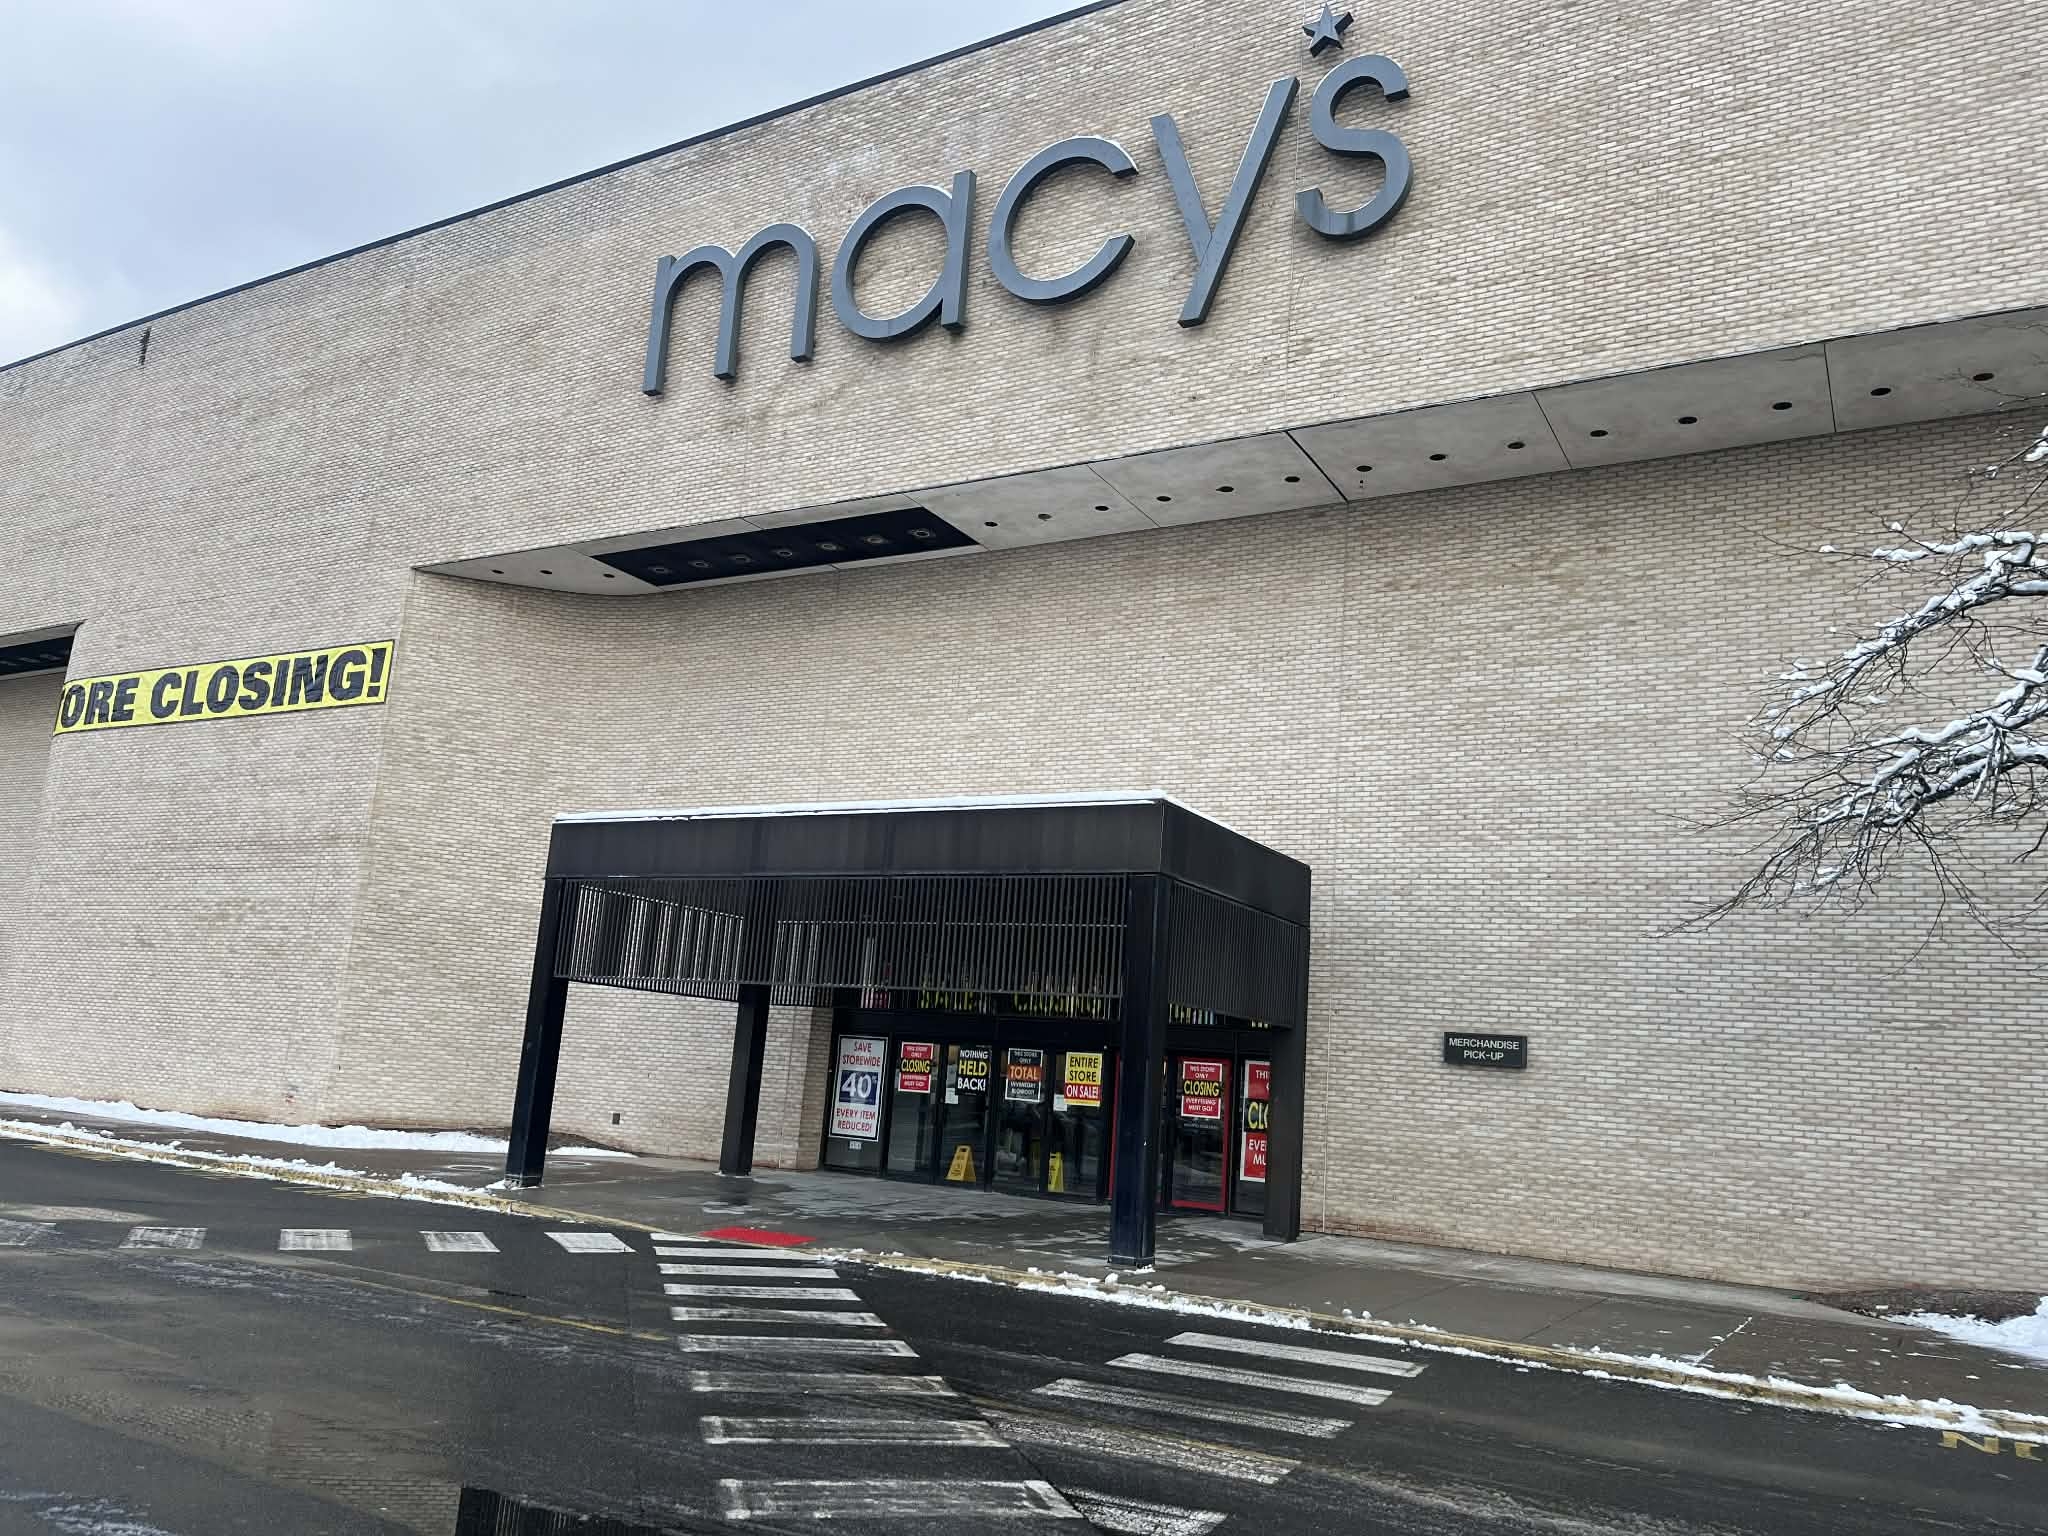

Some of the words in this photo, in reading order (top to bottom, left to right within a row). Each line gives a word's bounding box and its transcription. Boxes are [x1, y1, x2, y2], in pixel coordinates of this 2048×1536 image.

[60, 677, 140, 728] ORE
[150, 647, 388, 719] CLOSING!
[854, 1041, 872, 1052] SAVE
[1449, 1037, 1519, 1050] MERCHANDISE
[960, 1049, 989, 1059] NOTHING
[1463, 1050, 1504, 1060] PICK-UP
[842, 1055, 880, 1066] STOREWIDE
[901, 1059, 930, 1073] CLOSING
[1070, 1056, 1098, 1068] ENTIRE
[959, 1060, 987, 1076] HELD
[1010, 1066, 1038, 1080] TOTAL
[1070, 1070, 1096, 1082] STORE
[1256, 1070, 1269, 1079] THI
[957, 1078, 986, 1091] BACK!
[1184, 1080, 1219, 1096] CLOSING
[1066, 1085, 1078, 1097] ON
[1080, 1086, 1099, 1099] SALE!
[836, 1108, 858, 1118] EVERY
[860, 1110, 876, 1120] ITEM
[837, 1120, 872, 1132] REDUCED!
[1249, 1139, 1267, 1151] EVE
